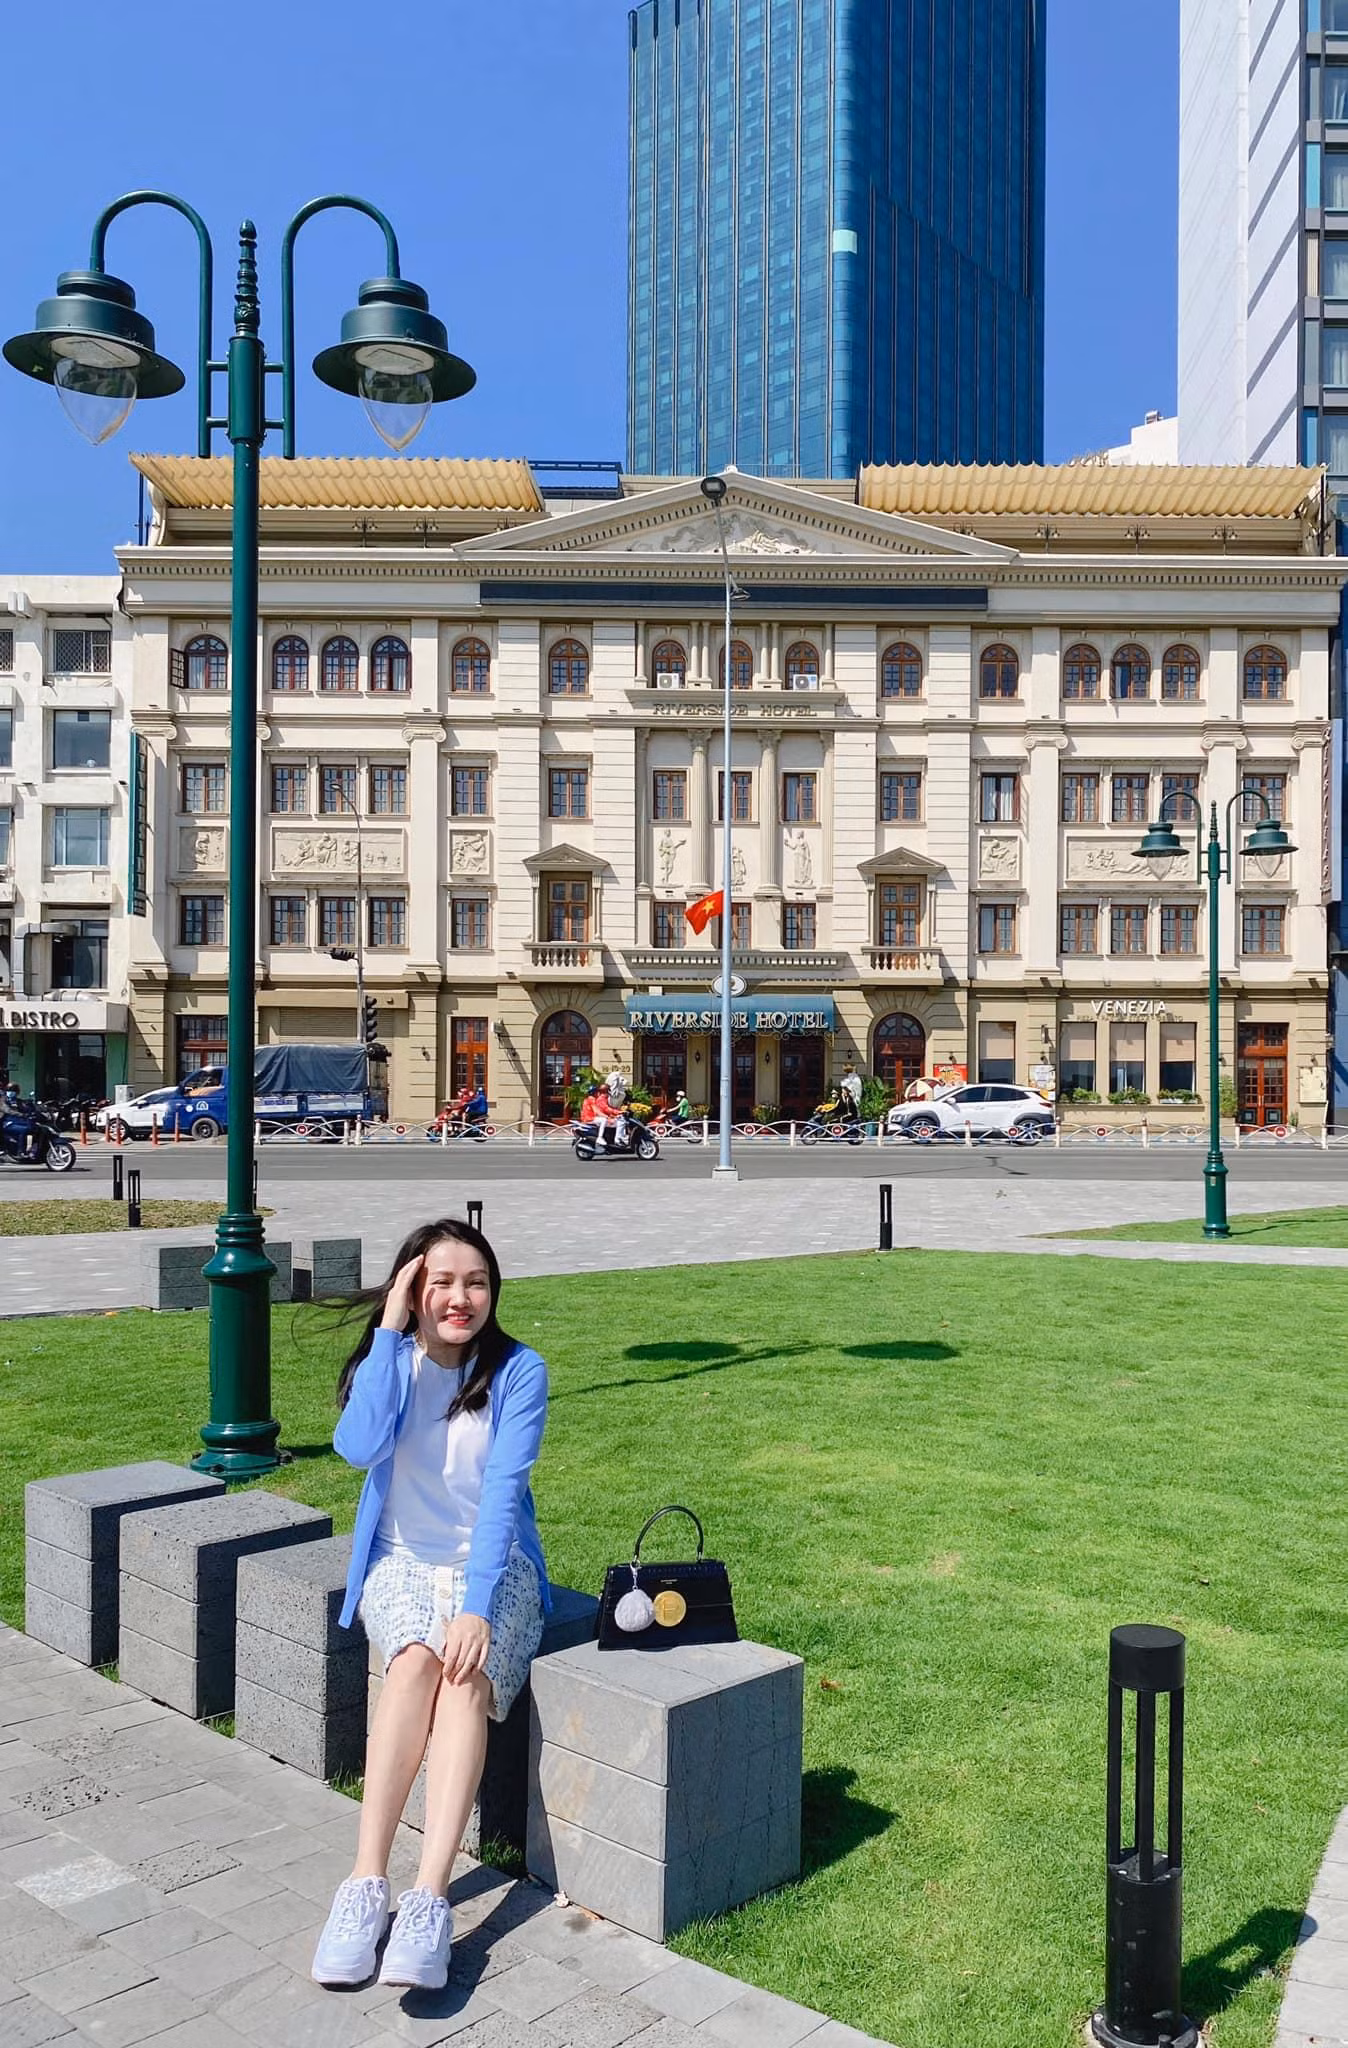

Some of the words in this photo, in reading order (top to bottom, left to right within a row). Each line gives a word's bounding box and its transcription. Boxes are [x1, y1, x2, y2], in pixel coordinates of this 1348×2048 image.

[760, 704, 817, 717] HOTEL
[1091, 1000, 1166, 1014] VENEZIA
[755, 1011, 829, 1029] HOTEL
